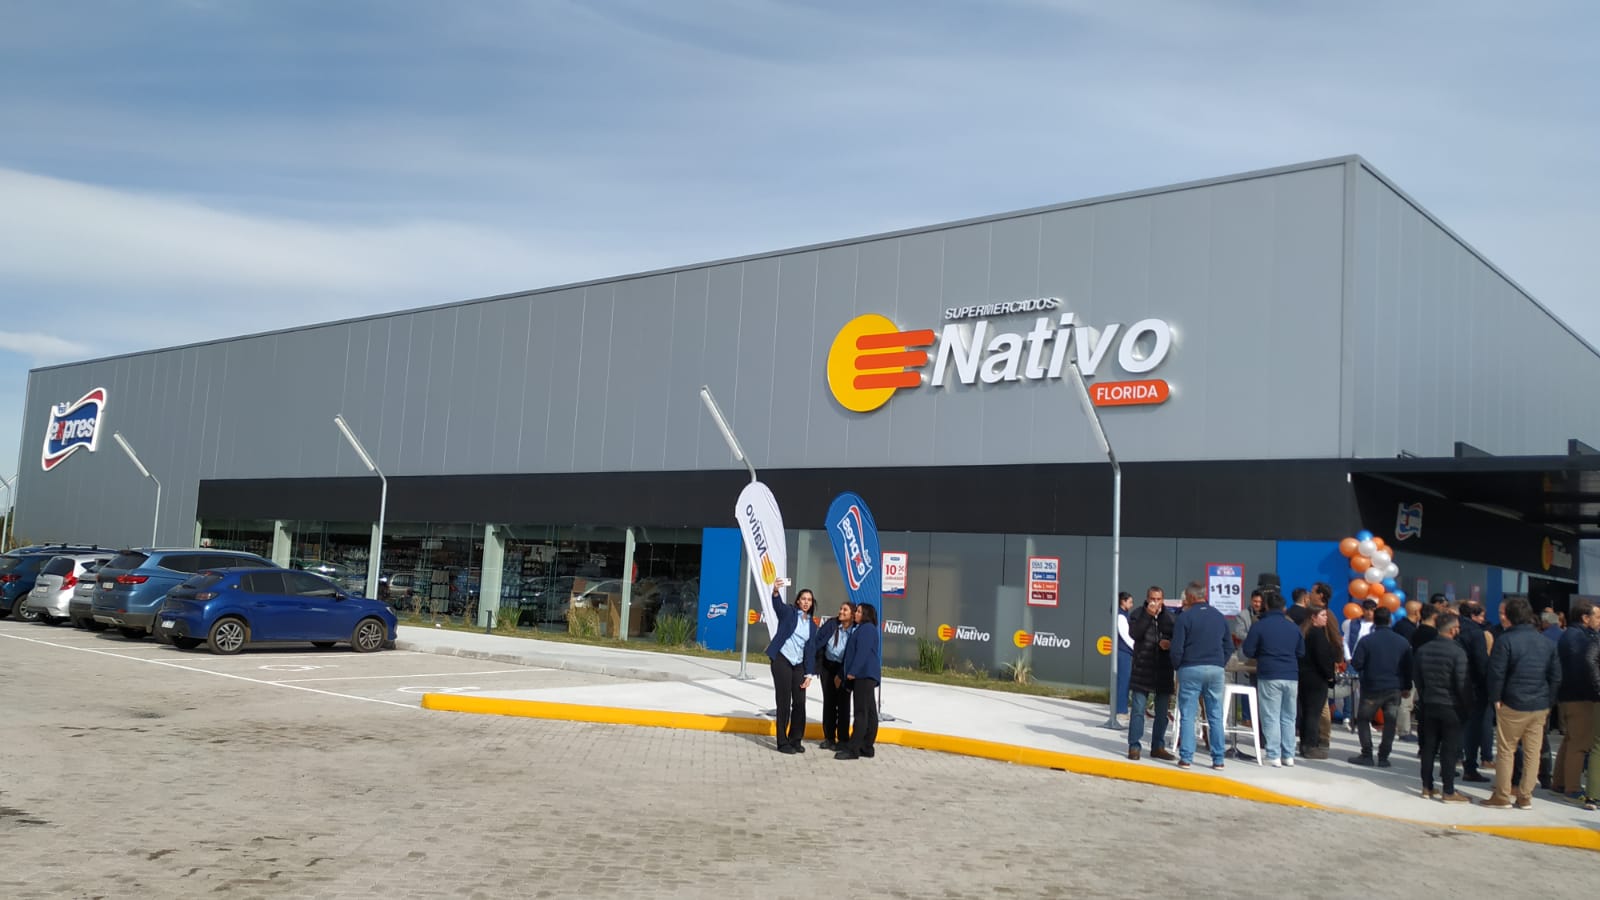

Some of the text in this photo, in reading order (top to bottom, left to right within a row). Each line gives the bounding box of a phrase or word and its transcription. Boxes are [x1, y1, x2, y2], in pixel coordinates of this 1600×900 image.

[944, 297, 1059, 320] SUPERMERCADOS
[931, 313, 1171, 386] Nativo
[1096, 385, 1159, 401] FLORIDA
[49, 417, 95, 446] expres
[1211, 583, 1240, 595] $119
[883, 622, 916, 636] Nativo
[955, 628, 990, 642] Nativo
[1033, 634, 1071, 649] Nativo
